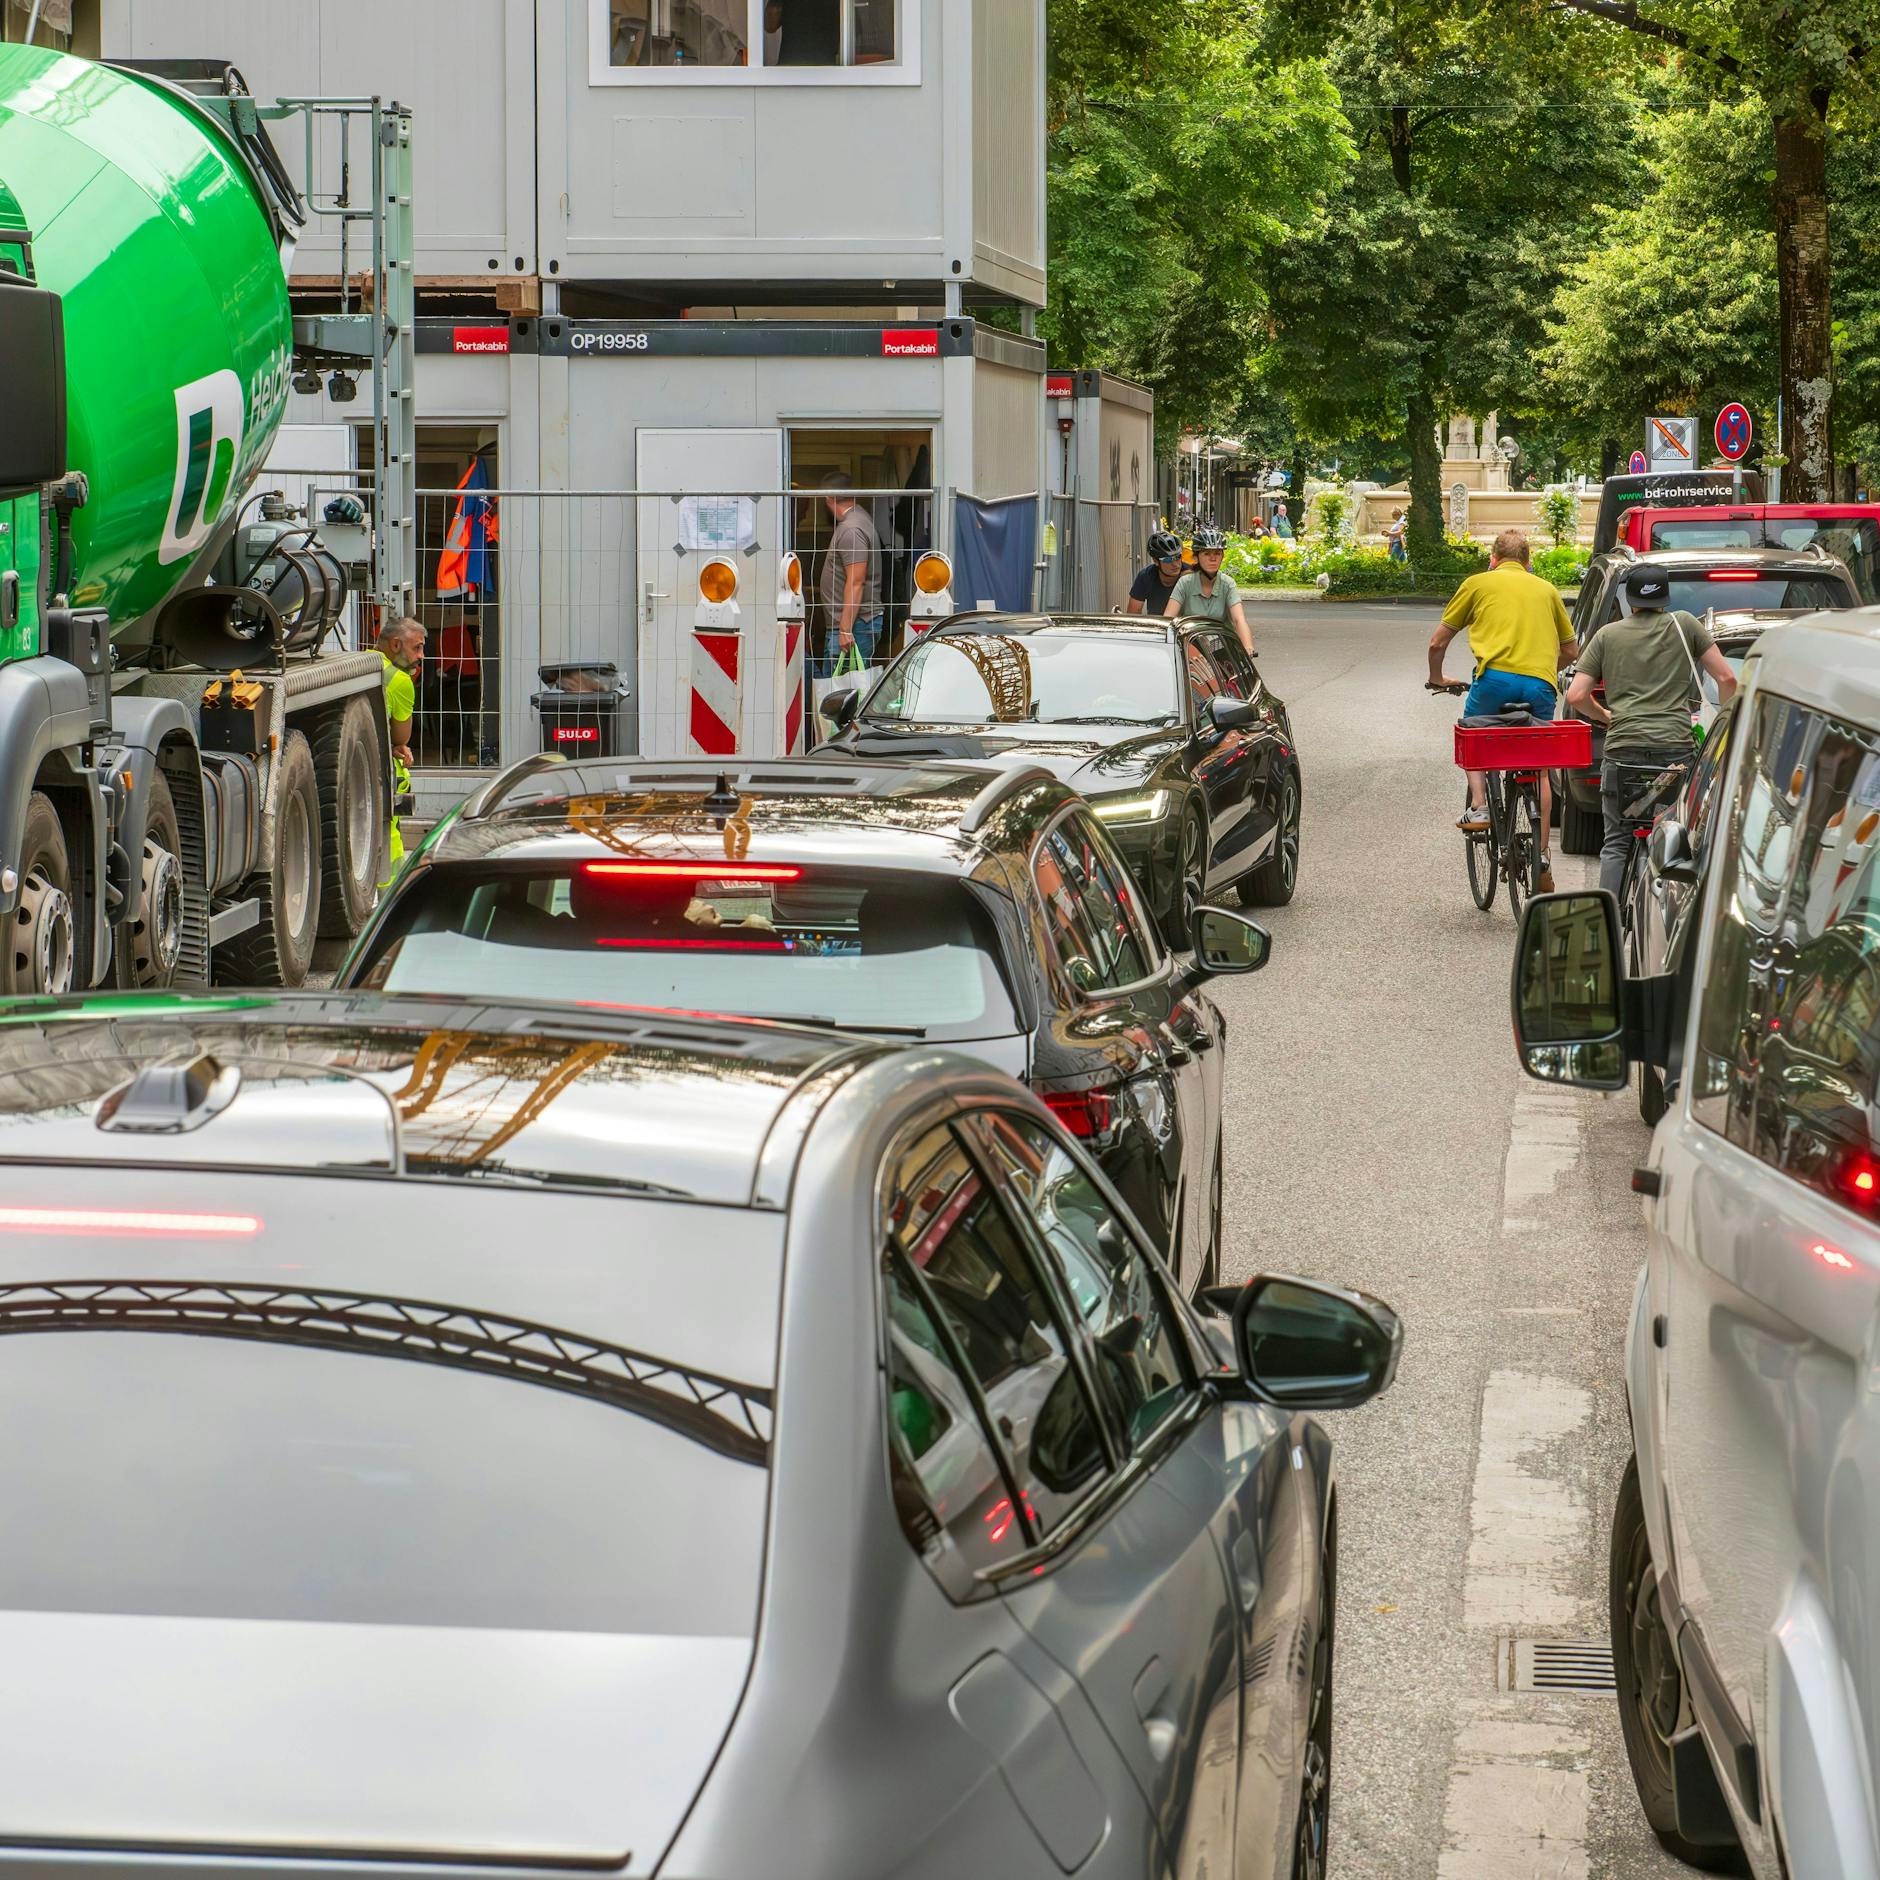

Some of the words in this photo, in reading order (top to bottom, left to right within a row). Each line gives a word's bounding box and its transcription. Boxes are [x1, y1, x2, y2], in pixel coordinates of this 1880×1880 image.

[571, 333, 648, 349] OP19958
[456, 341, 507, 351] Portakabin
[884, 344, 936, 353] Portakabin
[558, 730, 592, 739] SULO
